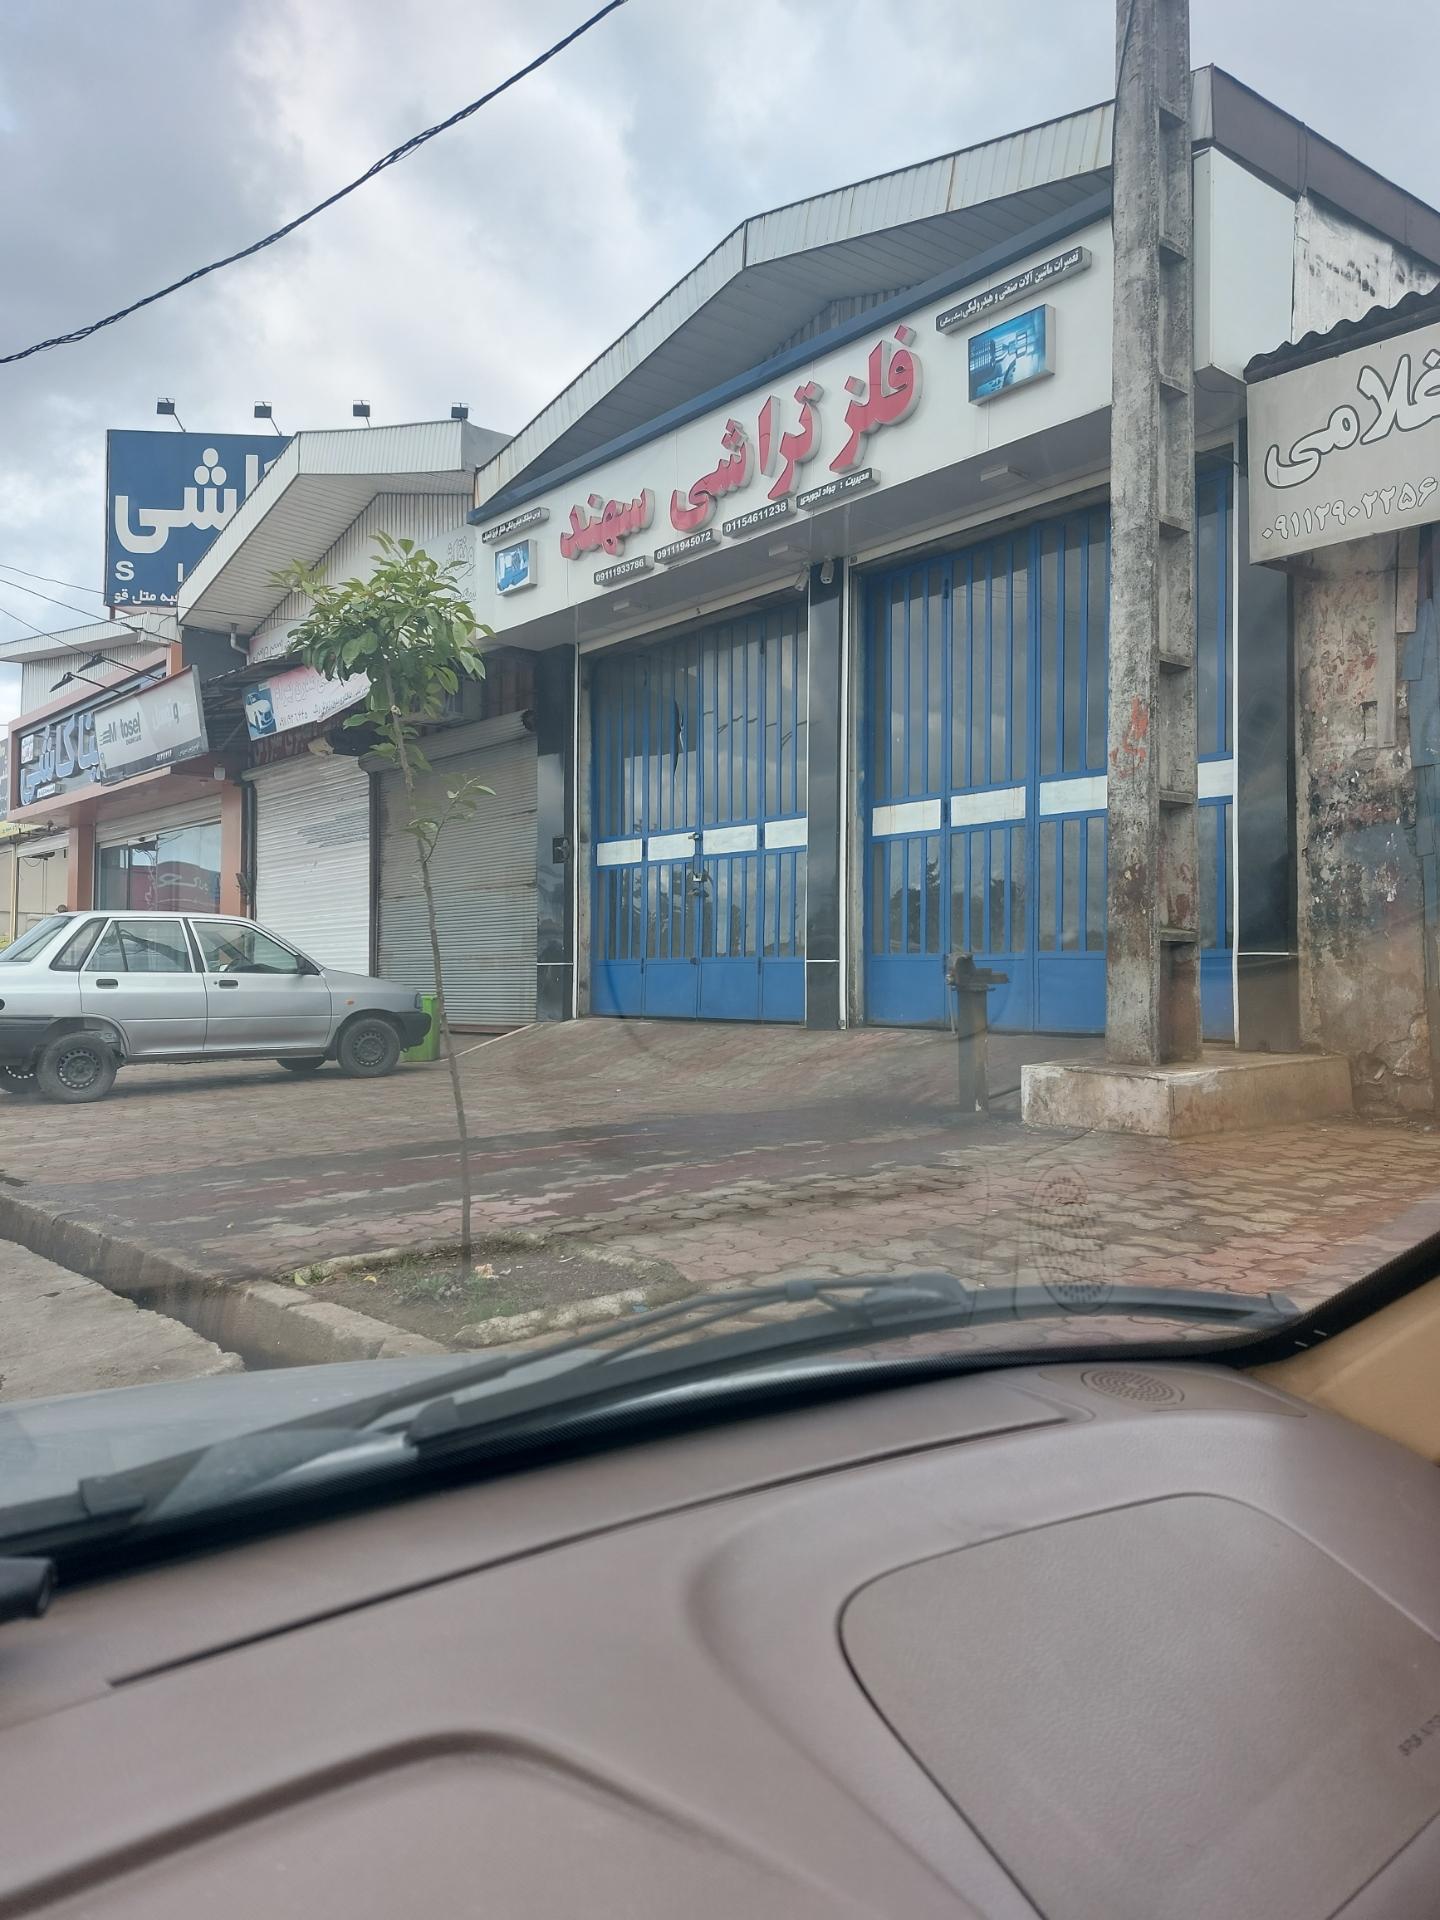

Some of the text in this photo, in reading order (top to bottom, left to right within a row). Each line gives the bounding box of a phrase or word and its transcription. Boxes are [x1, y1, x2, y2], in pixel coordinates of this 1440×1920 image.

[1019, 269, 1034, 287] آلات
[1034, 264, 1053, 284] ماشین
[998, 281, 1018, 300] صنعتی
[559, 324, 922, 561] فلز تراشی سهند
[115, 447, 276, 554] اشی
[725, 502, 787, 533] 01154611238
[656, 531, 711, 560] 09111945072
[113, 588, 129, 604] قو
[131, 589, 156, 604] متل
